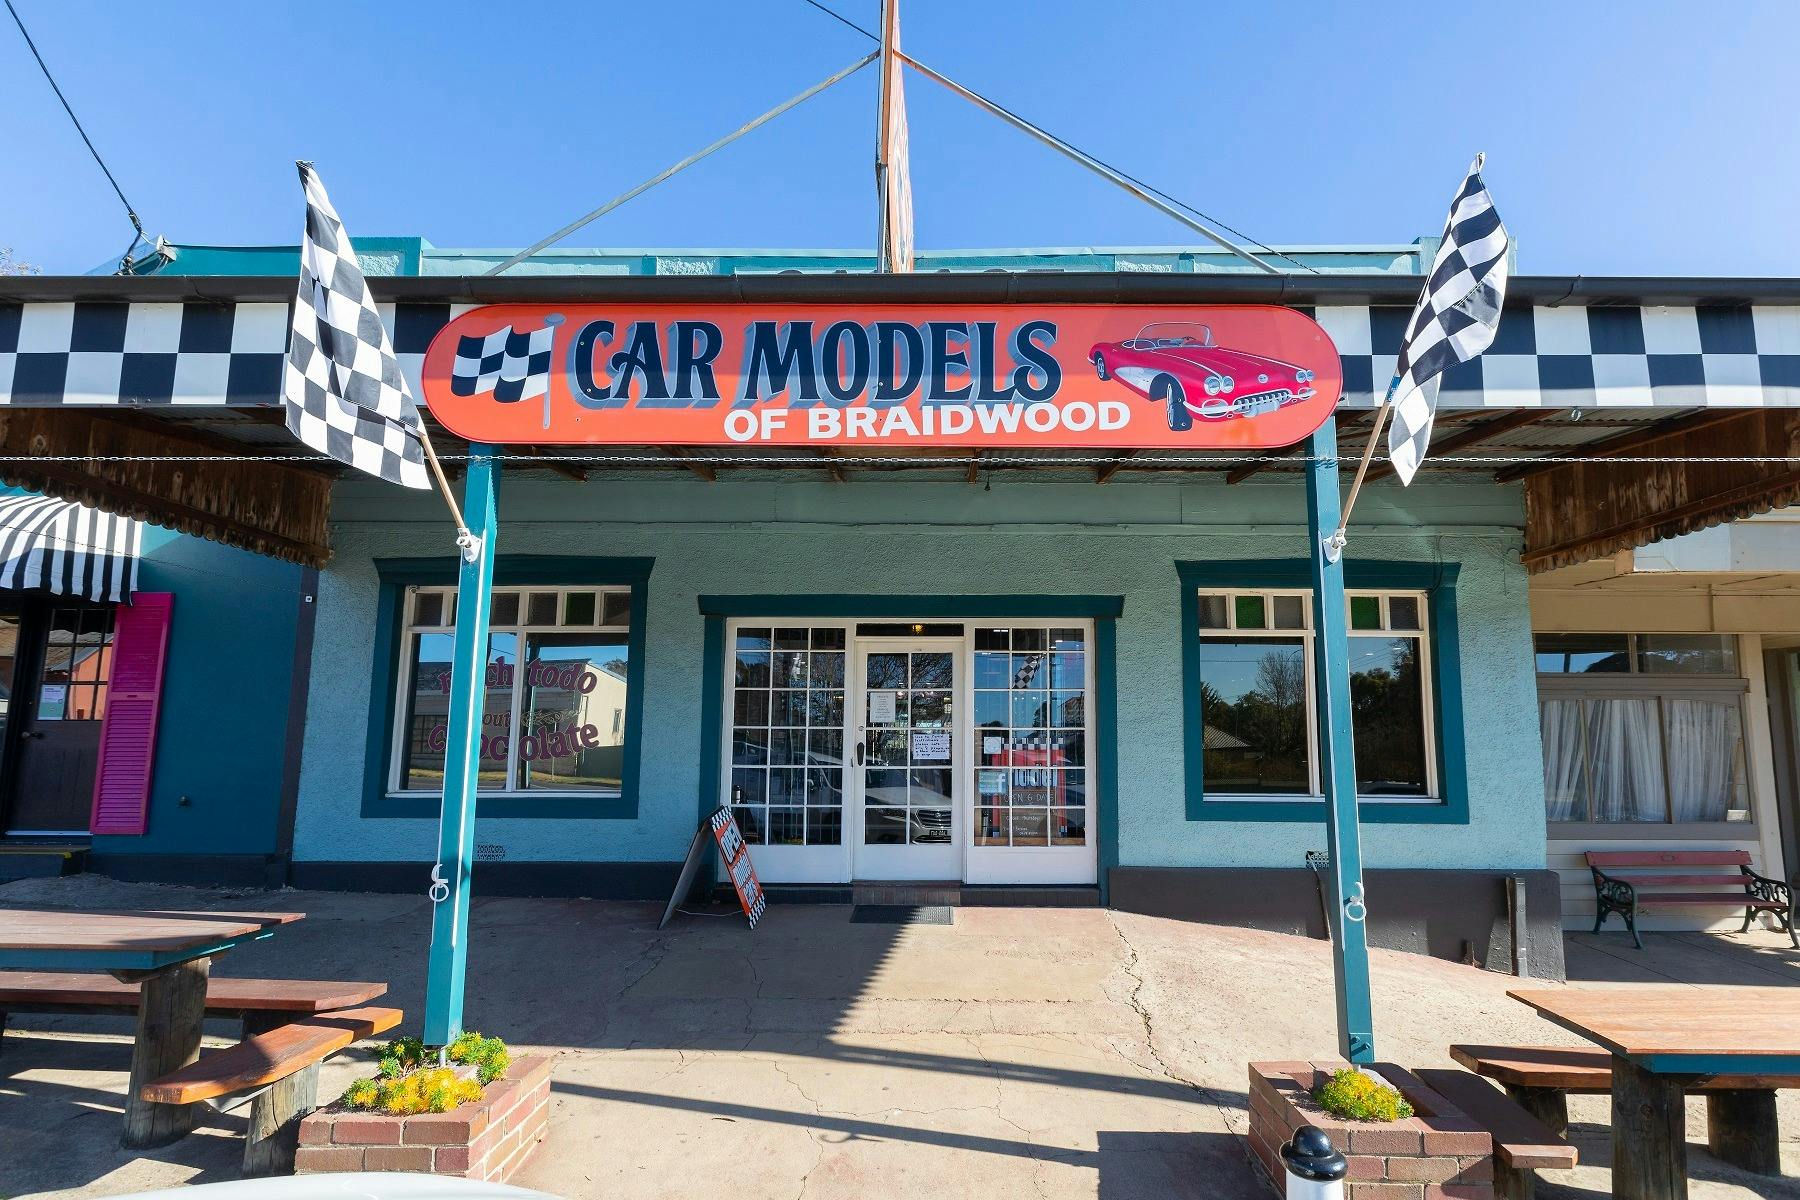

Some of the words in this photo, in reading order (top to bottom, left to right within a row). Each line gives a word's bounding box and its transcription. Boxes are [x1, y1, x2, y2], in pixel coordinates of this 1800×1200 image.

[568, 320, 723, 405] CAR
[736, 319, 1063, 405] MODELS
[724, 409, 788, 441] OF
[808, 401, 1131, 439] BRAIDWOOD
